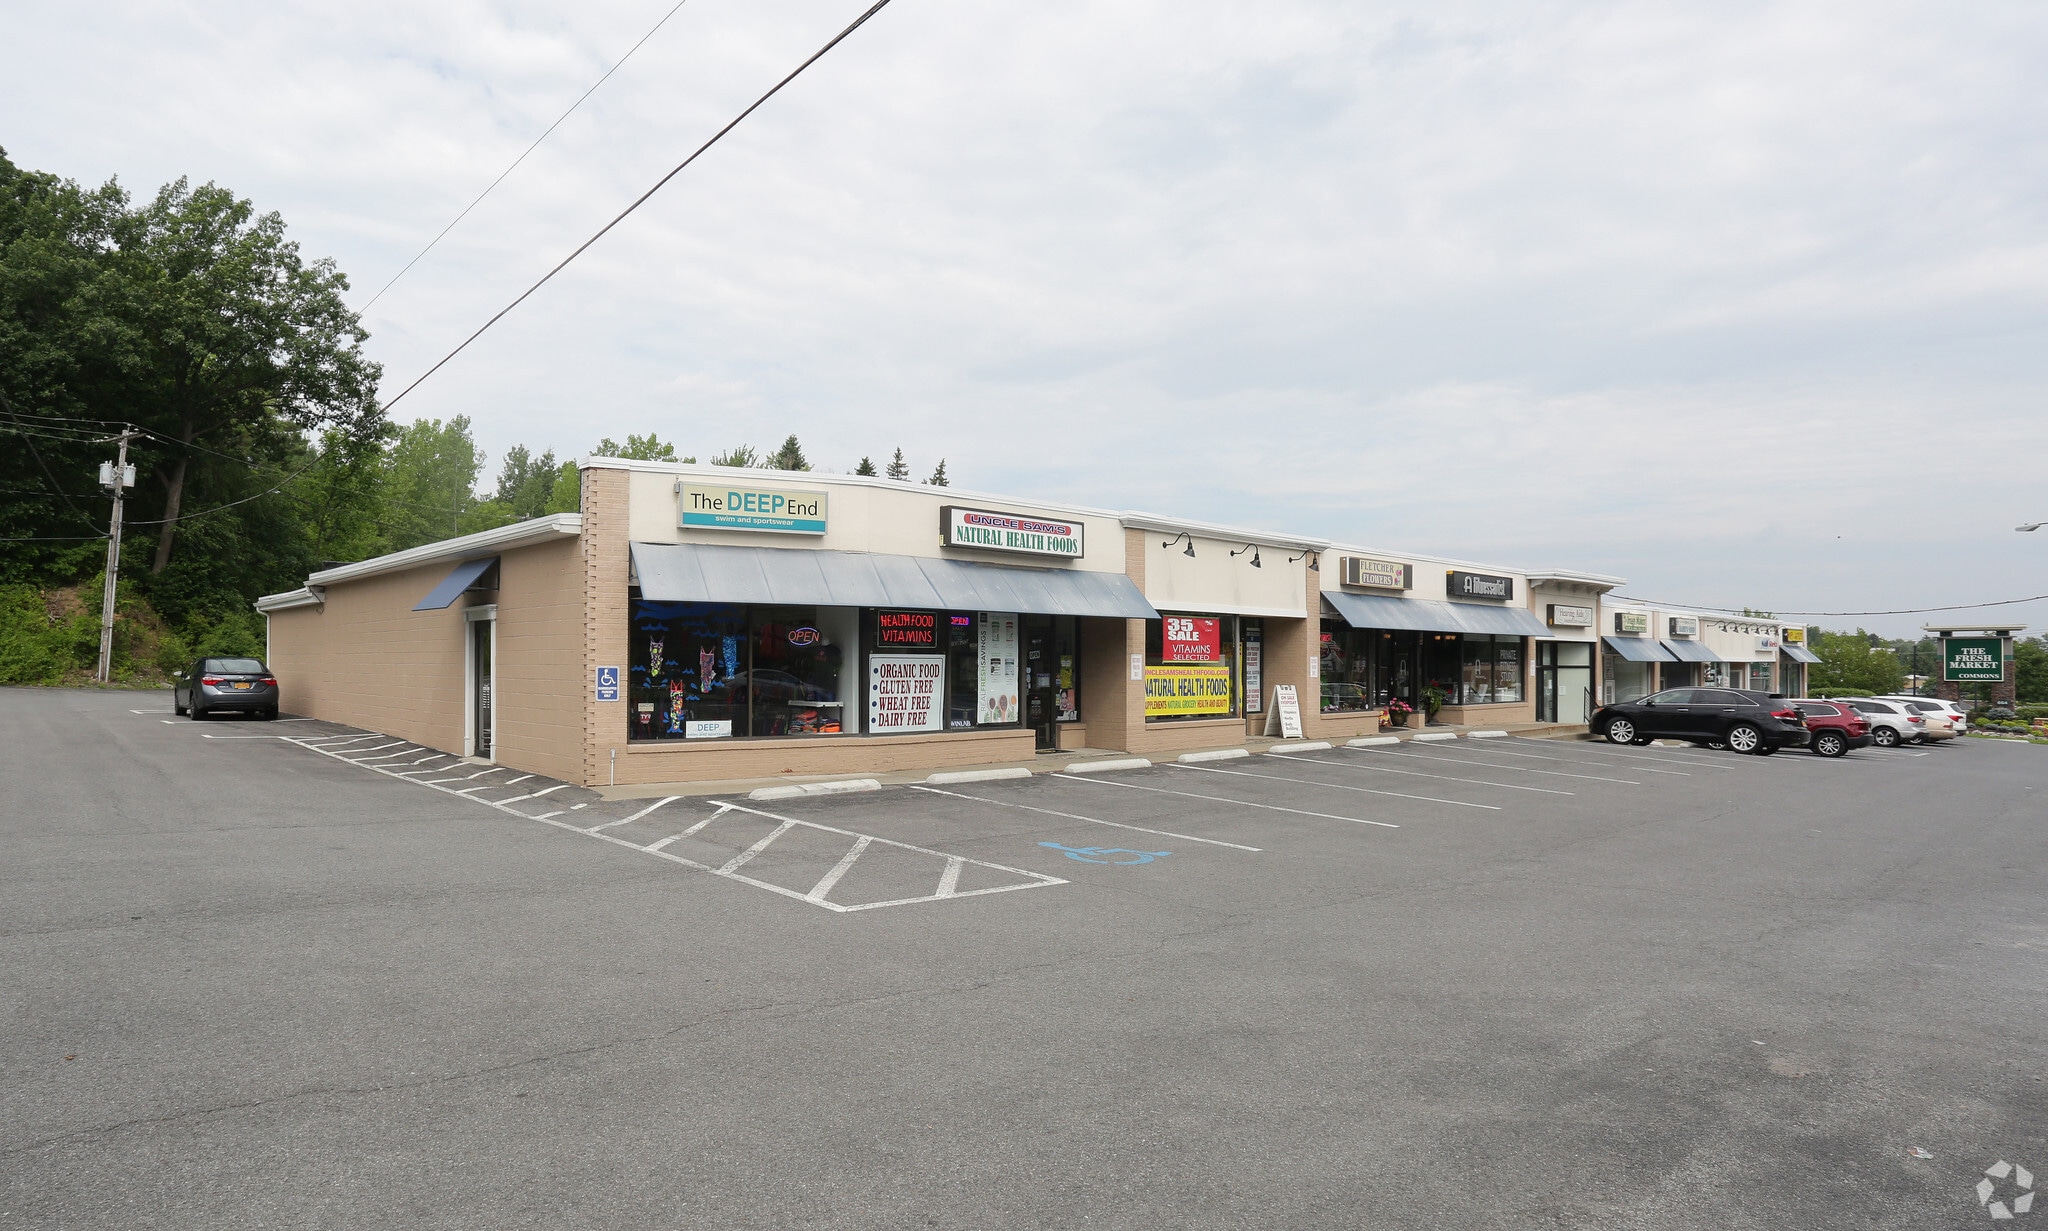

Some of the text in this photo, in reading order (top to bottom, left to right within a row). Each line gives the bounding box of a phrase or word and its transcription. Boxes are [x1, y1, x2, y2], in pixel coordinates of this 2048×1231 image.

[690, 491, 818, 516] The DEEP End
[715, 515, 736, 523] swim
[753, 517, 794, 526] sportswear
[970, 514, 1066, 534] UNCLE SAM'S
[956, 525, 1078, 554] NATURAL HEALTH FOODS
[1360, 560, 1395, 574] FLETCHER
[1363, 574, 1392, 585] FLOWERS
[880, 614, 934, 627] HEALTH FOOD
[1167, 618, 1194, 632] 35
[788, 630, 820, 642] OPEN
[882, 630, 933, 643] VITAMINS
[1167, 631, 1200, 641] SALE
[1172, 644, 1211, 654] VITAMINS
[880, 663, 940, 679] ORGANIC FOOD
[879, 680, 934, 695] GLUTEN FREE
[1145, 678, 1228, 697] NATURAL HEALTH FOODS
[879, 696, 931, 711] WHEAT FREE
[1168, 700, 1182, 709] NATURAL
[1182, 700, 1197, 708] GROCERY
[1197, 699, 1208, 708] HEALTH
[1216, 699, 1227, 707] BEAUTY
[878, 712, 927, 727] DAIRY FREE
[697, 724, 720, 732] DEEP
